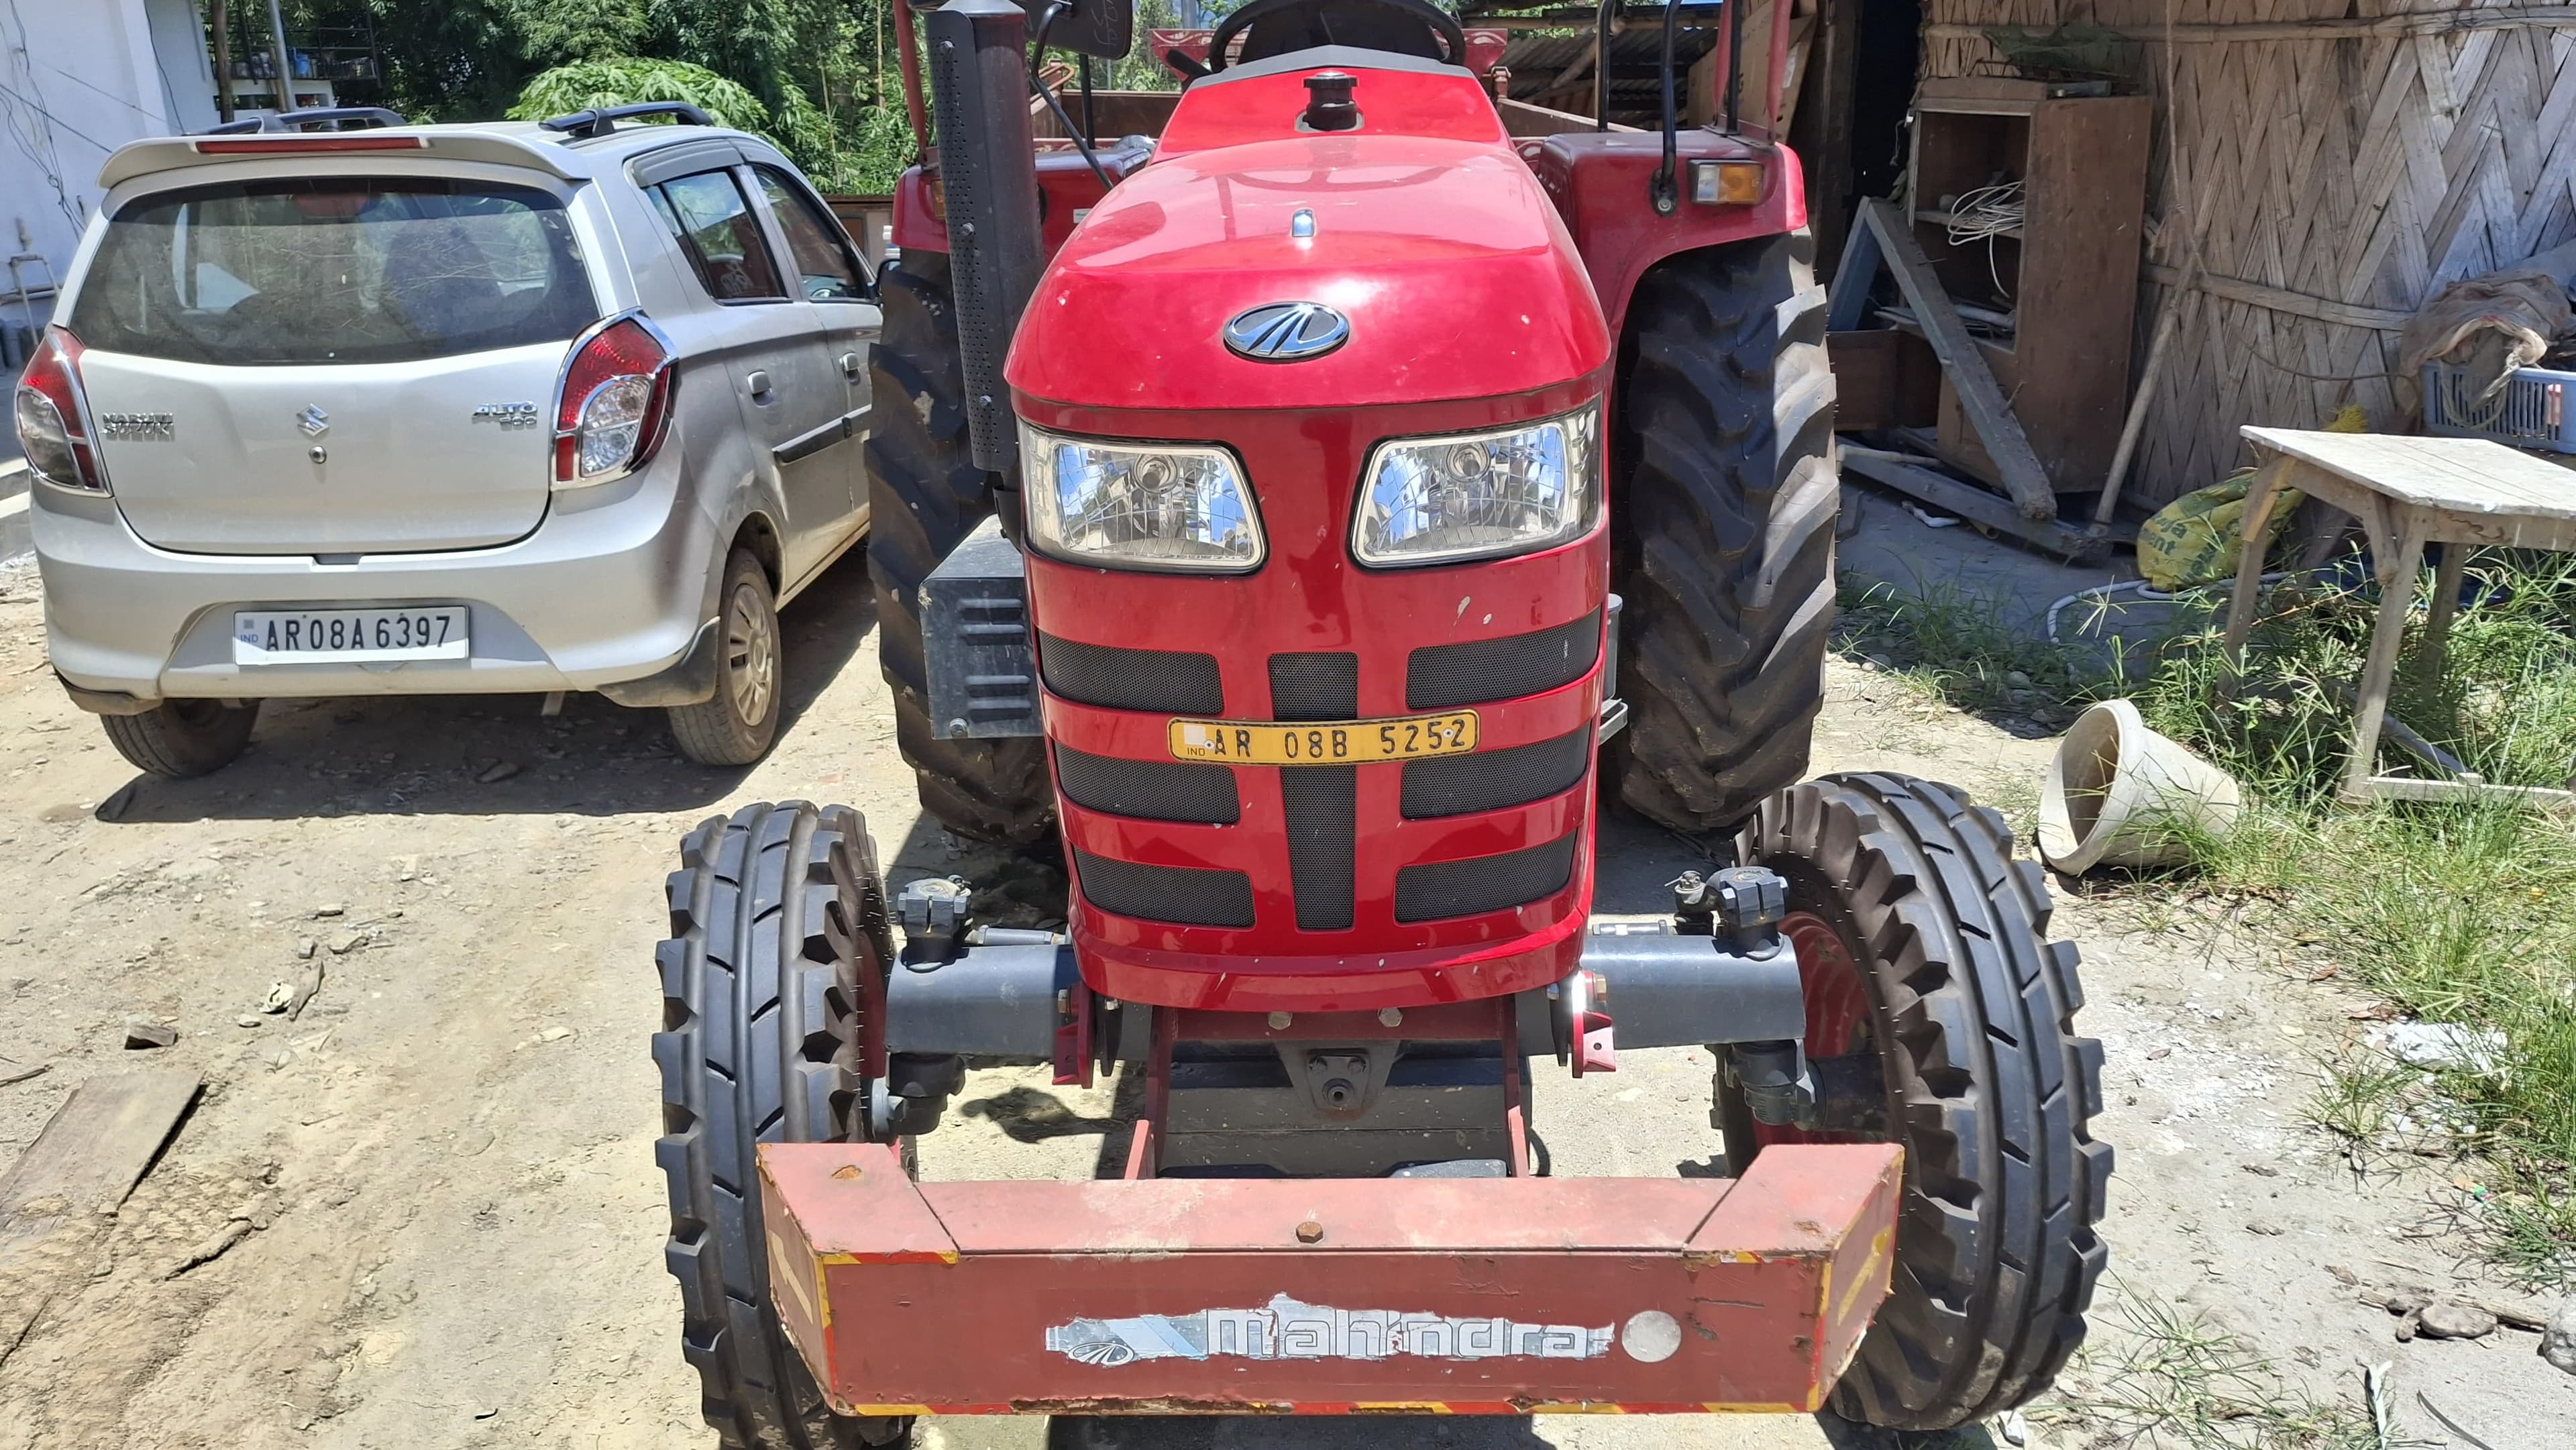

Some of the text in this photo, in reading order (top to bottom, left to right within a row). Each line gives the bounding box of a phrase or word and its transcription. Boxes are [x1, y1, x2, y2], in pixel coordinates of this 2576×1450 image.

[472, 401, 537, 415] ALTO
[498, 416, 537, 425] 800
[240, 634, 258, 643] IND
[1215, 719, 1466, 759] AR 08B 5252
[1187, 747, 1205, 756] IND
